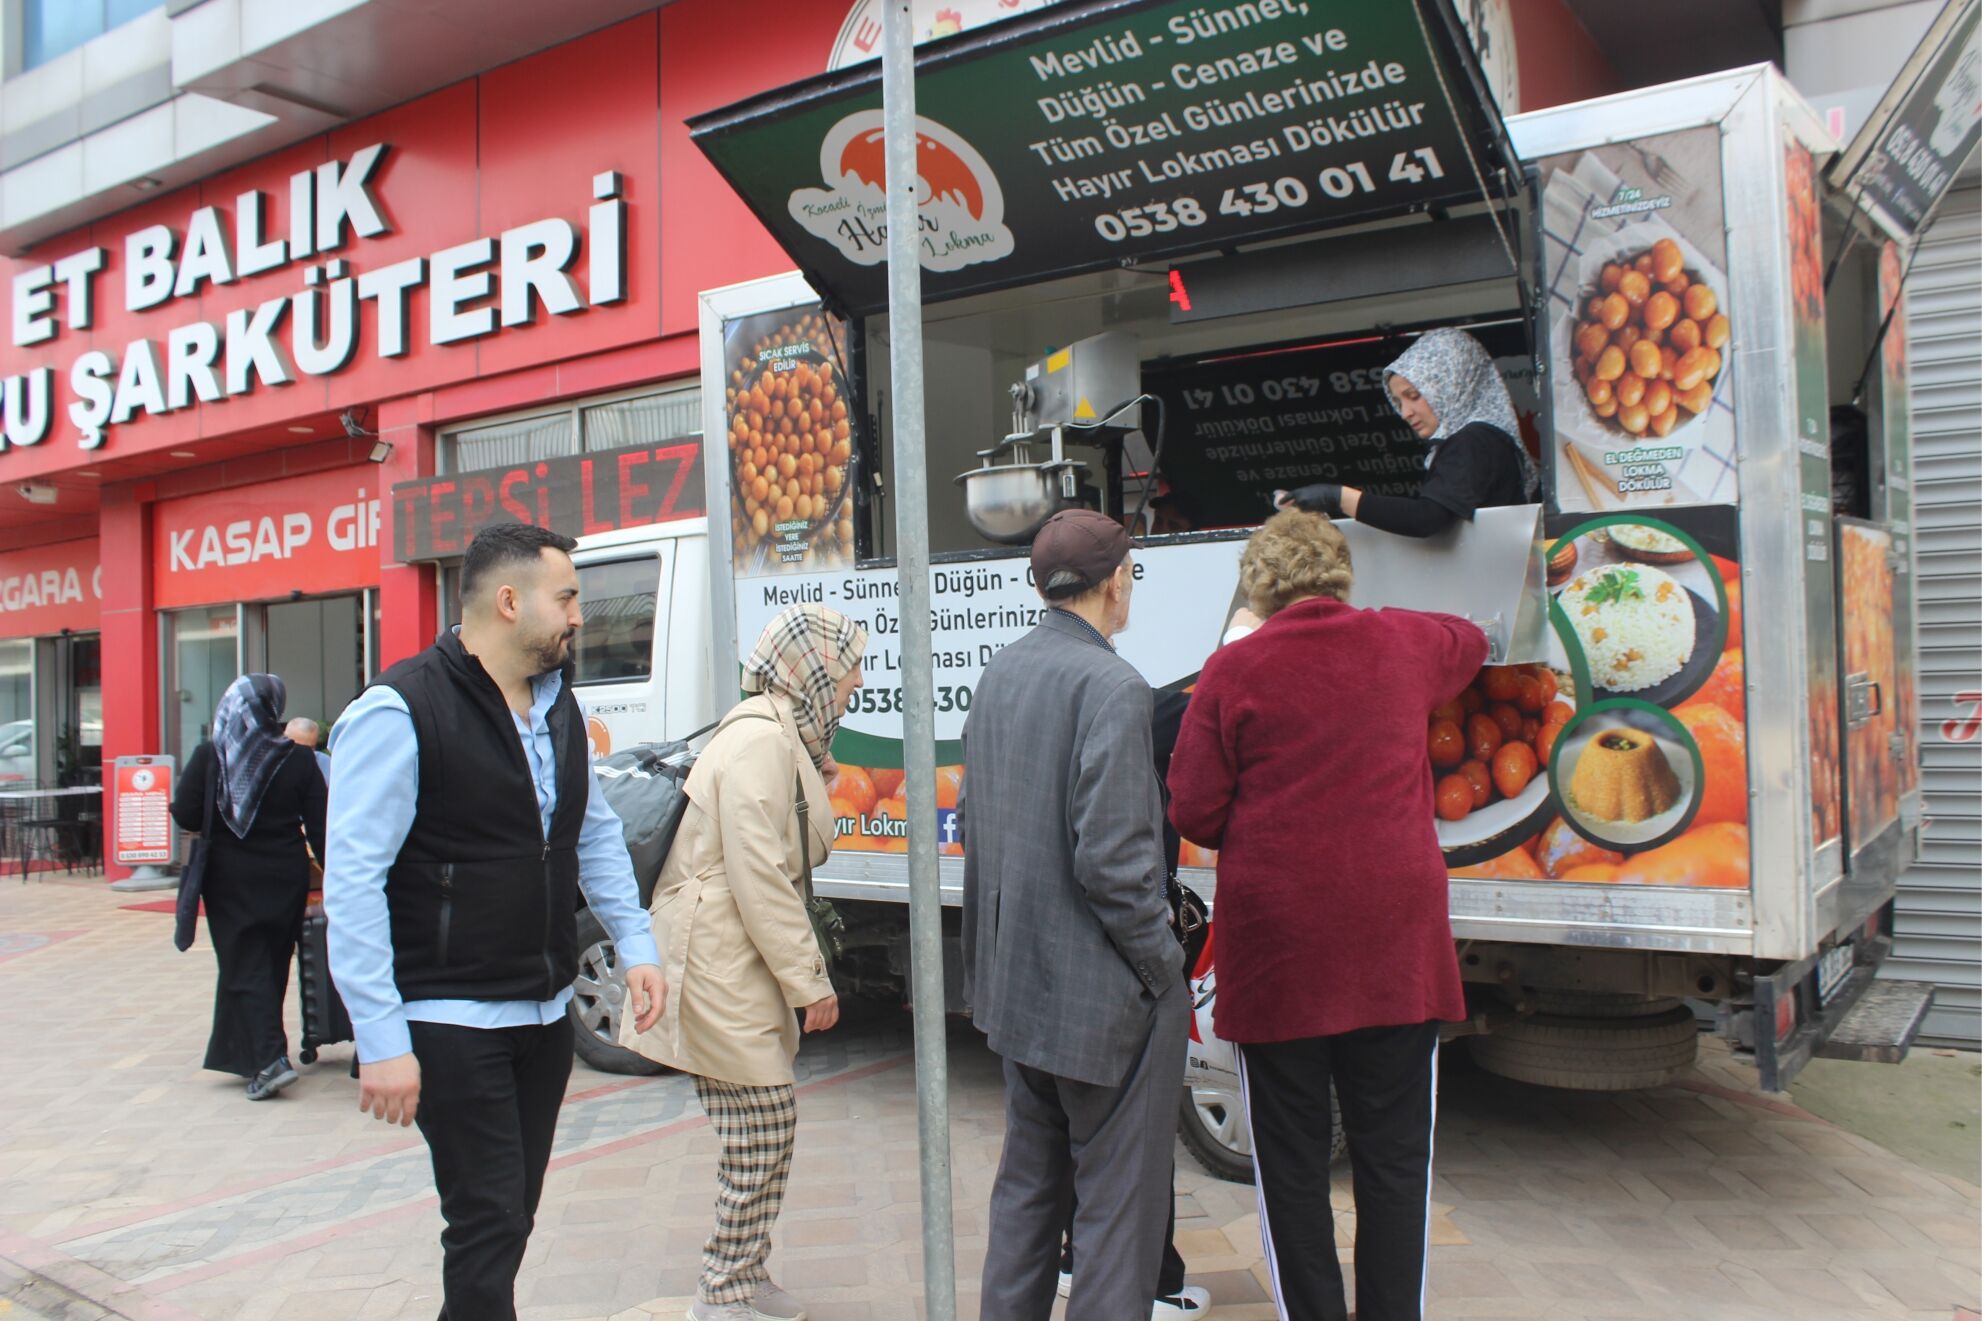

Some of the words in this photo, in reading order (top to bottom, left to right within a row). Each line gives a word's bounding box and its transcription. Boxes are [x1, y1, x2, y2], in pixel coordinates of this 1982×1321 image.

[1029, 30, 1144, 82] Mevlid
[1167, 0, 1310, 47] Sünnet,
[1037, 80, 1146, 123] Düğün
[1171, 41, 1298, 90] Cenaze
[1302, 28, 1349, 57] ve
[1029, 134, 1104, 167] Tüm
[1102, 113, 1182, 150] Özel
[1183, 61, 1407, 132] Günlerinizde
[1051, 167, 1134, 202] Hayır
[1138, 137, 1281, 184] Lokması
[1283, 101, 1426, 153] Dökülür
[1094, 197, 1208, 242] 0538
[1218, 176, 1309, 218] 430
[1318, 161, 1377, 199] 01
[1387, 146, 1446, 184] 41
[12, 246, 106, 347] ET
[125, 143, 394, 313] BALIK
[838, 213, 939, 251] Har
[922, 231, 995, 257] Lokma
[68, 170, 628, 450] ŞARKÜTERİ
[759, 348, 783, 361] SICAK
[1329, 367, 1384, 393] 538
[1623, 463, 1665, 478] LOKMA
[170, 512, 312, 572] KASAP
[0, 567, 83, 612] GARA
[763, 582, 823, 606] Mevlid
[843, 578, 899, 600] Sünne
[934, 568, 1002, 597] Düğün
[875, 608, 899, 633] Öz
[933, 685, 973, 712] 30
[834, 817, 856, 840] yır
[860, 813, 907, 837] Lokm
